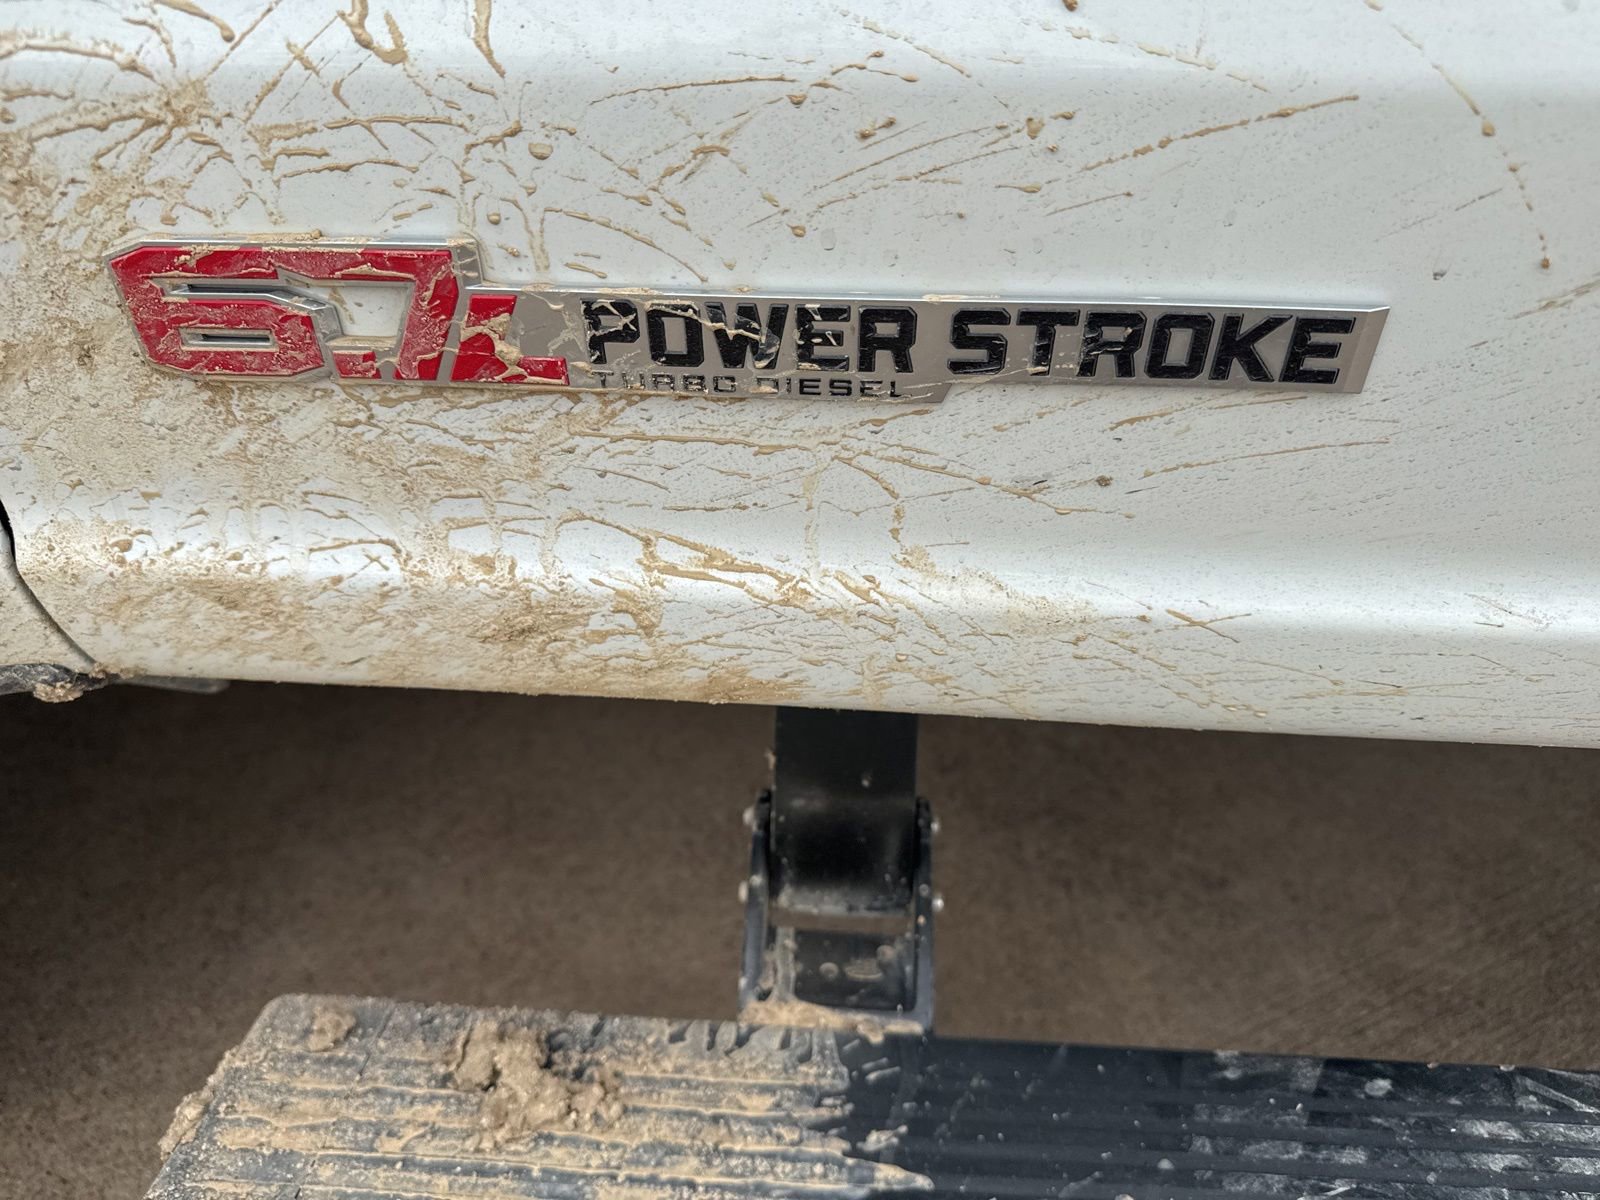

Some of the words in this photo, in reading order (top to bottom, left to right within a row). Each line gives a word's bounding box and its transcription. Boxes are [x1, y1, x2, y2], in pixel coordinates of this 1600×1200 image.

[580, 298, 917, 373] POWER
[947, 307, 1357, 385] STROKE
[591, 370, 737, 393] TURBO
[756, 376, 912, 398] DIESEL
